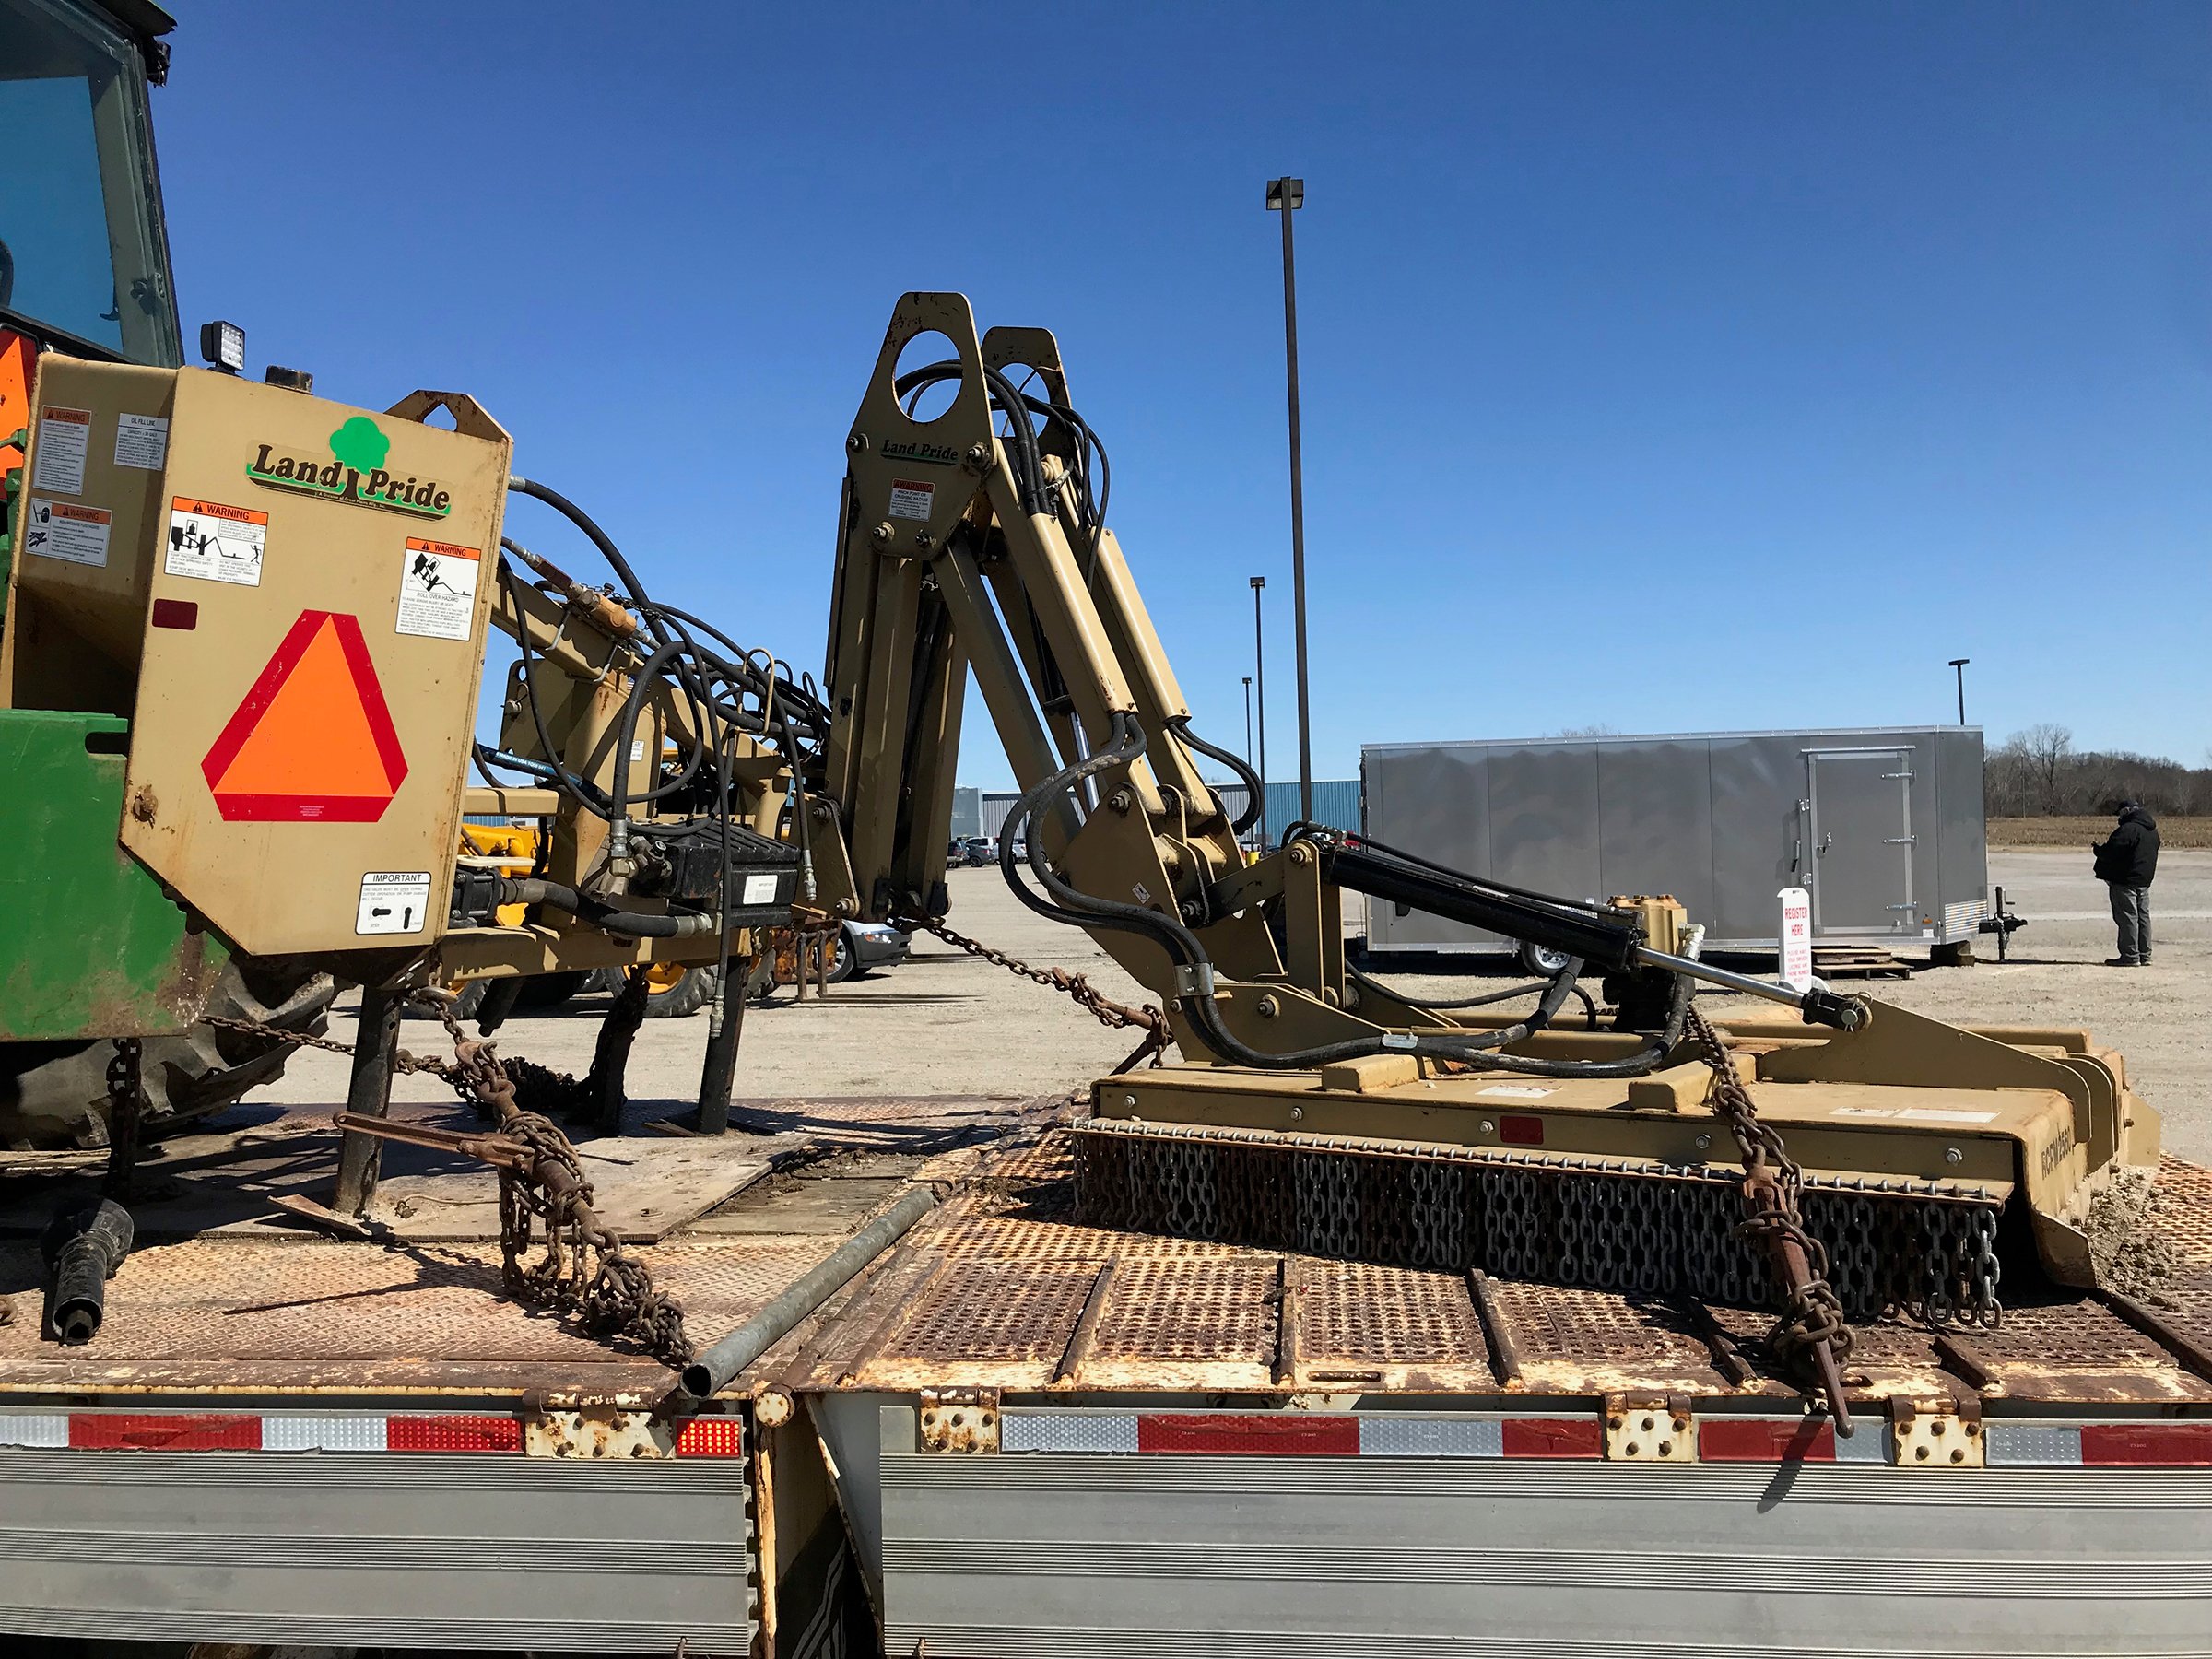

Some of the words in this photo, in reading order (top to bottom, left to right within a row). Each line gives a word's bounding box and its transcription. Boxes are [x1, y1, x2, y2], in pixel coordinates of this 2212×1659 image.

[55, 409, 86, 422] WARNING
[882, 439, 917, 455] Land
[920, 443, 959, 460] Pride
[253, 444, 344, 488] Land
[364, 468, 450, 510] Pride
[70, 508, 99, 521] WARNING
[206, 504, 250, 521] WARNING
[434, 544, 466, 557] WARNING
[372, 874, 422, 882] IMPORTANT
[1784, 906, 1808, 920] REGISTER
[1791, 924, 1804, 936] HERE
